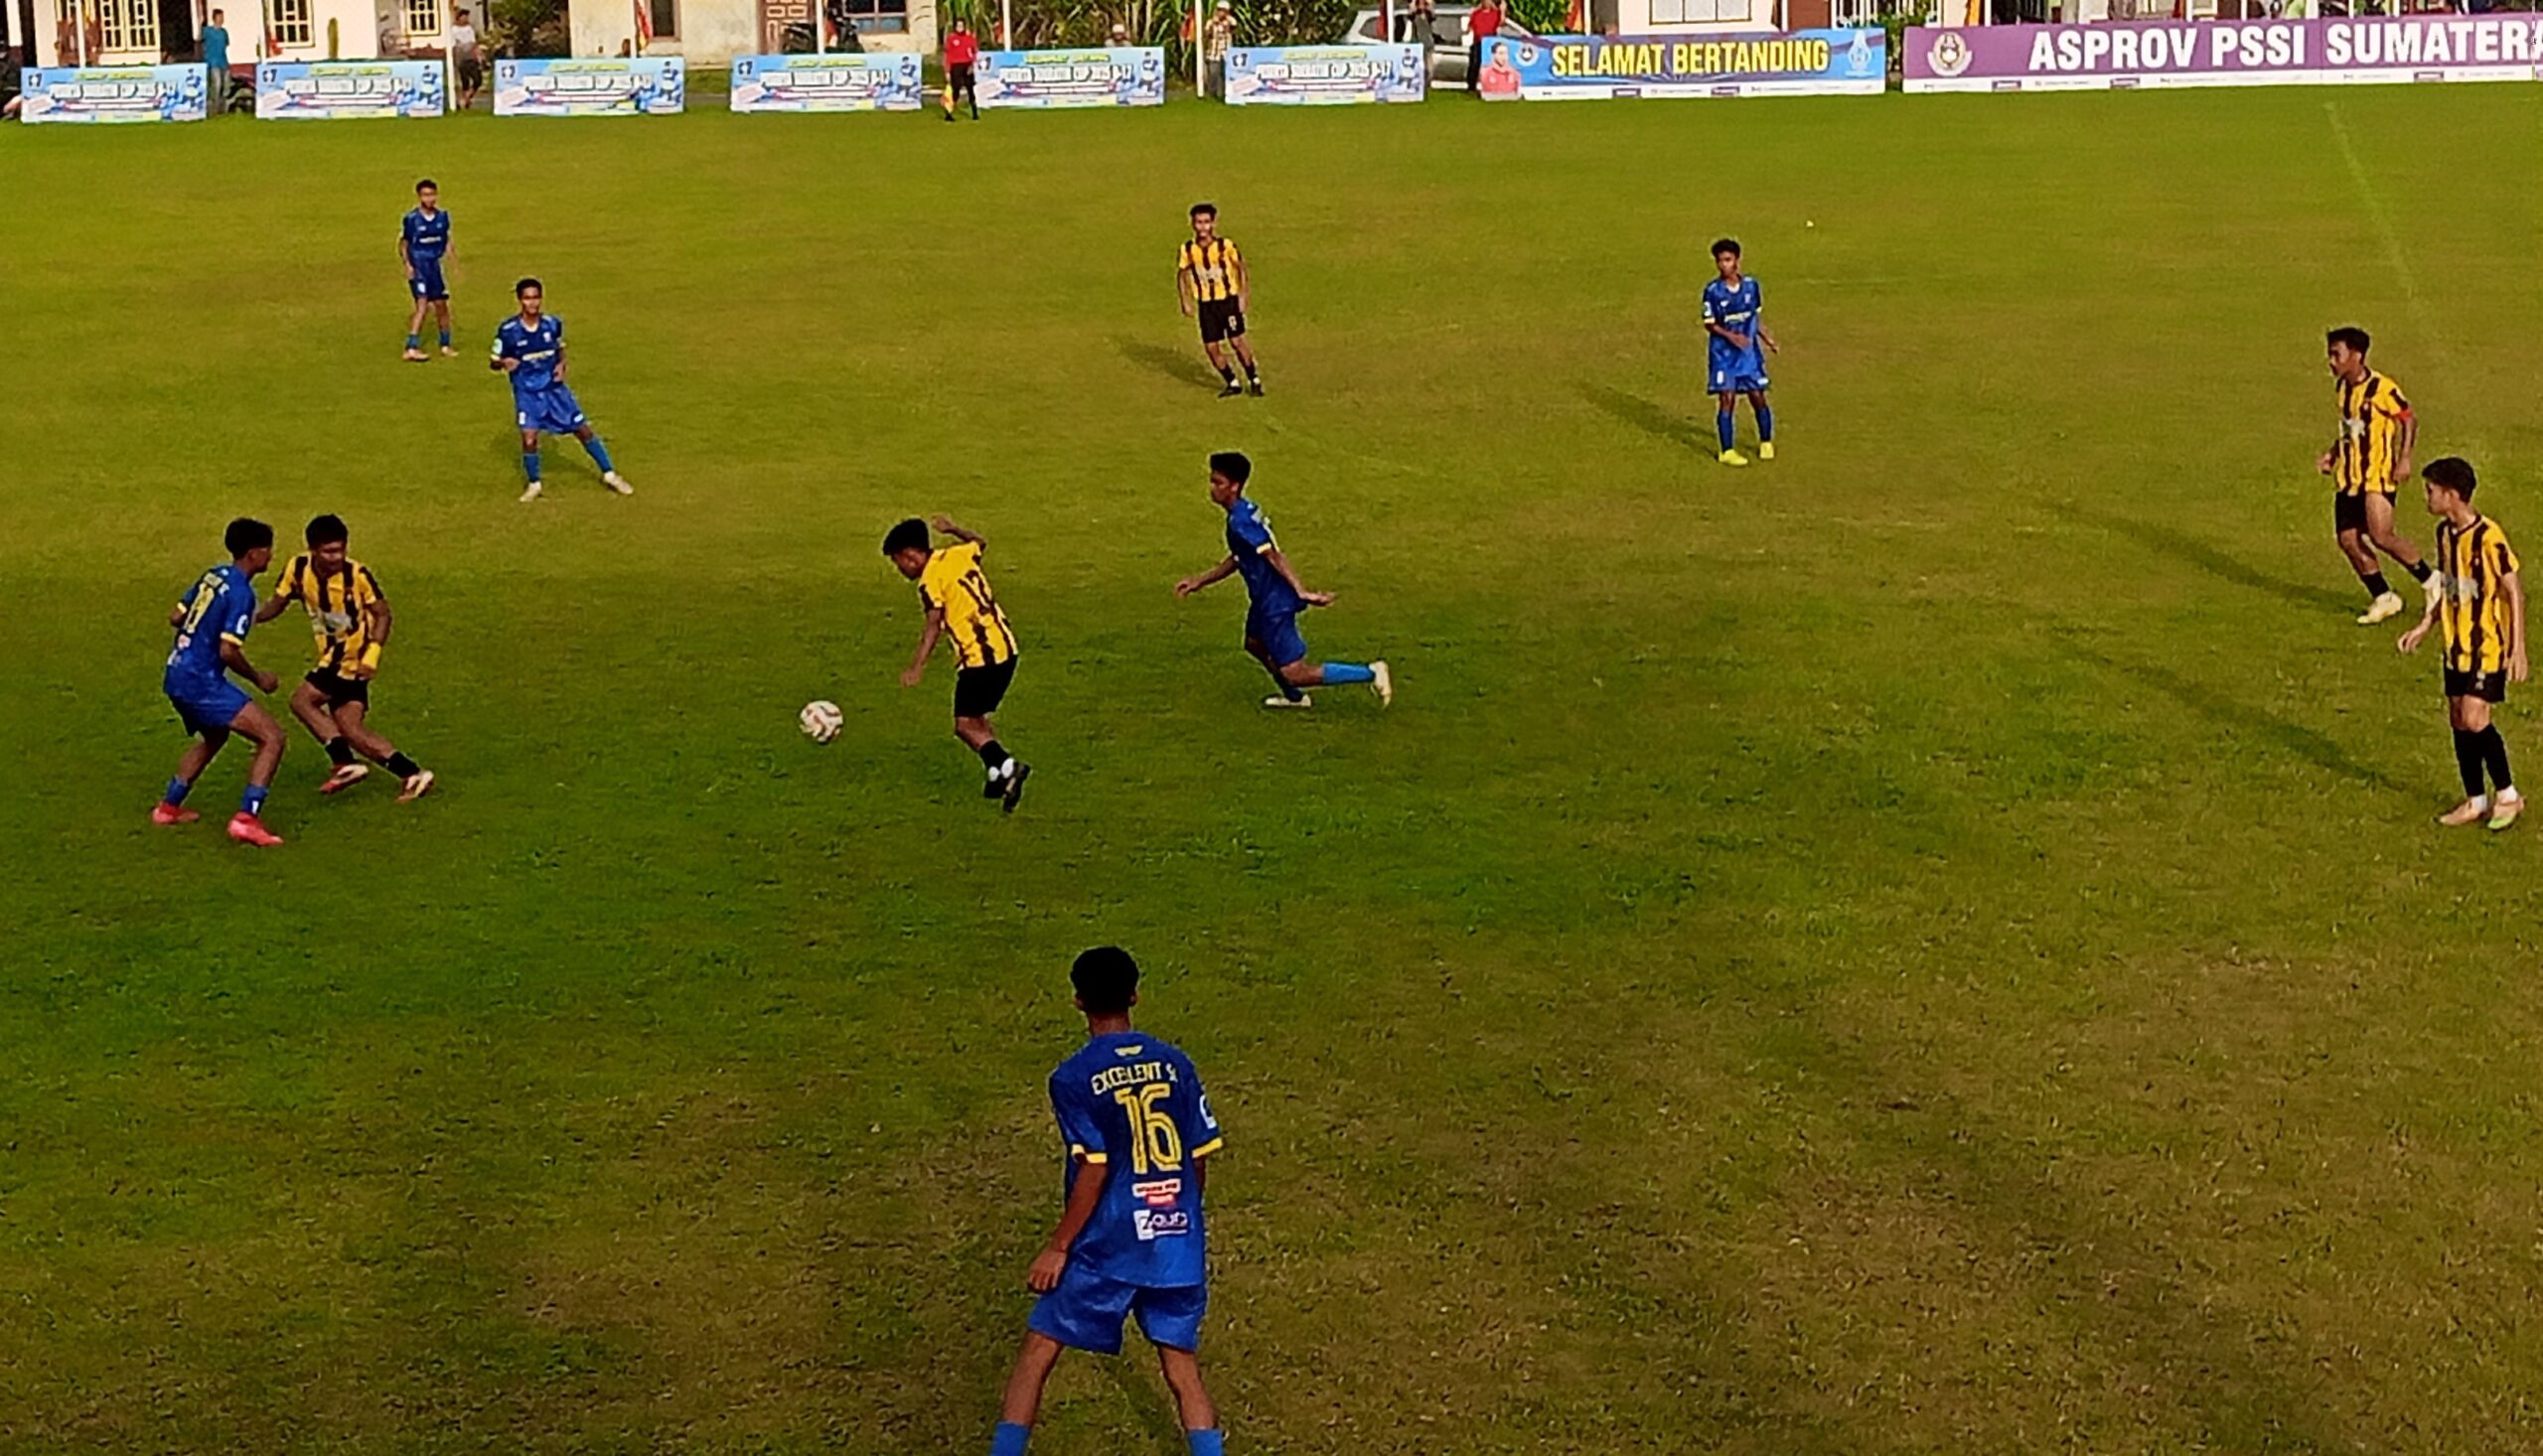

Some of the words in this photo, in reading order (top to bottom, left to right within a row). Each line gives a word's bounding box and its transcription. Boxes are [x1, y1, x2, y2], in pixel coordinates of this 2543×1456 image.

[1552, 43, 1665, 77] SELAMAT
[1672, 40, 1830, 74] BERTANDING
[2029, 28, 2197, 72] ASPROV
[2212, 24, 2305, 68] PSSI
[1115, 1084, 1182, 1174] 16
